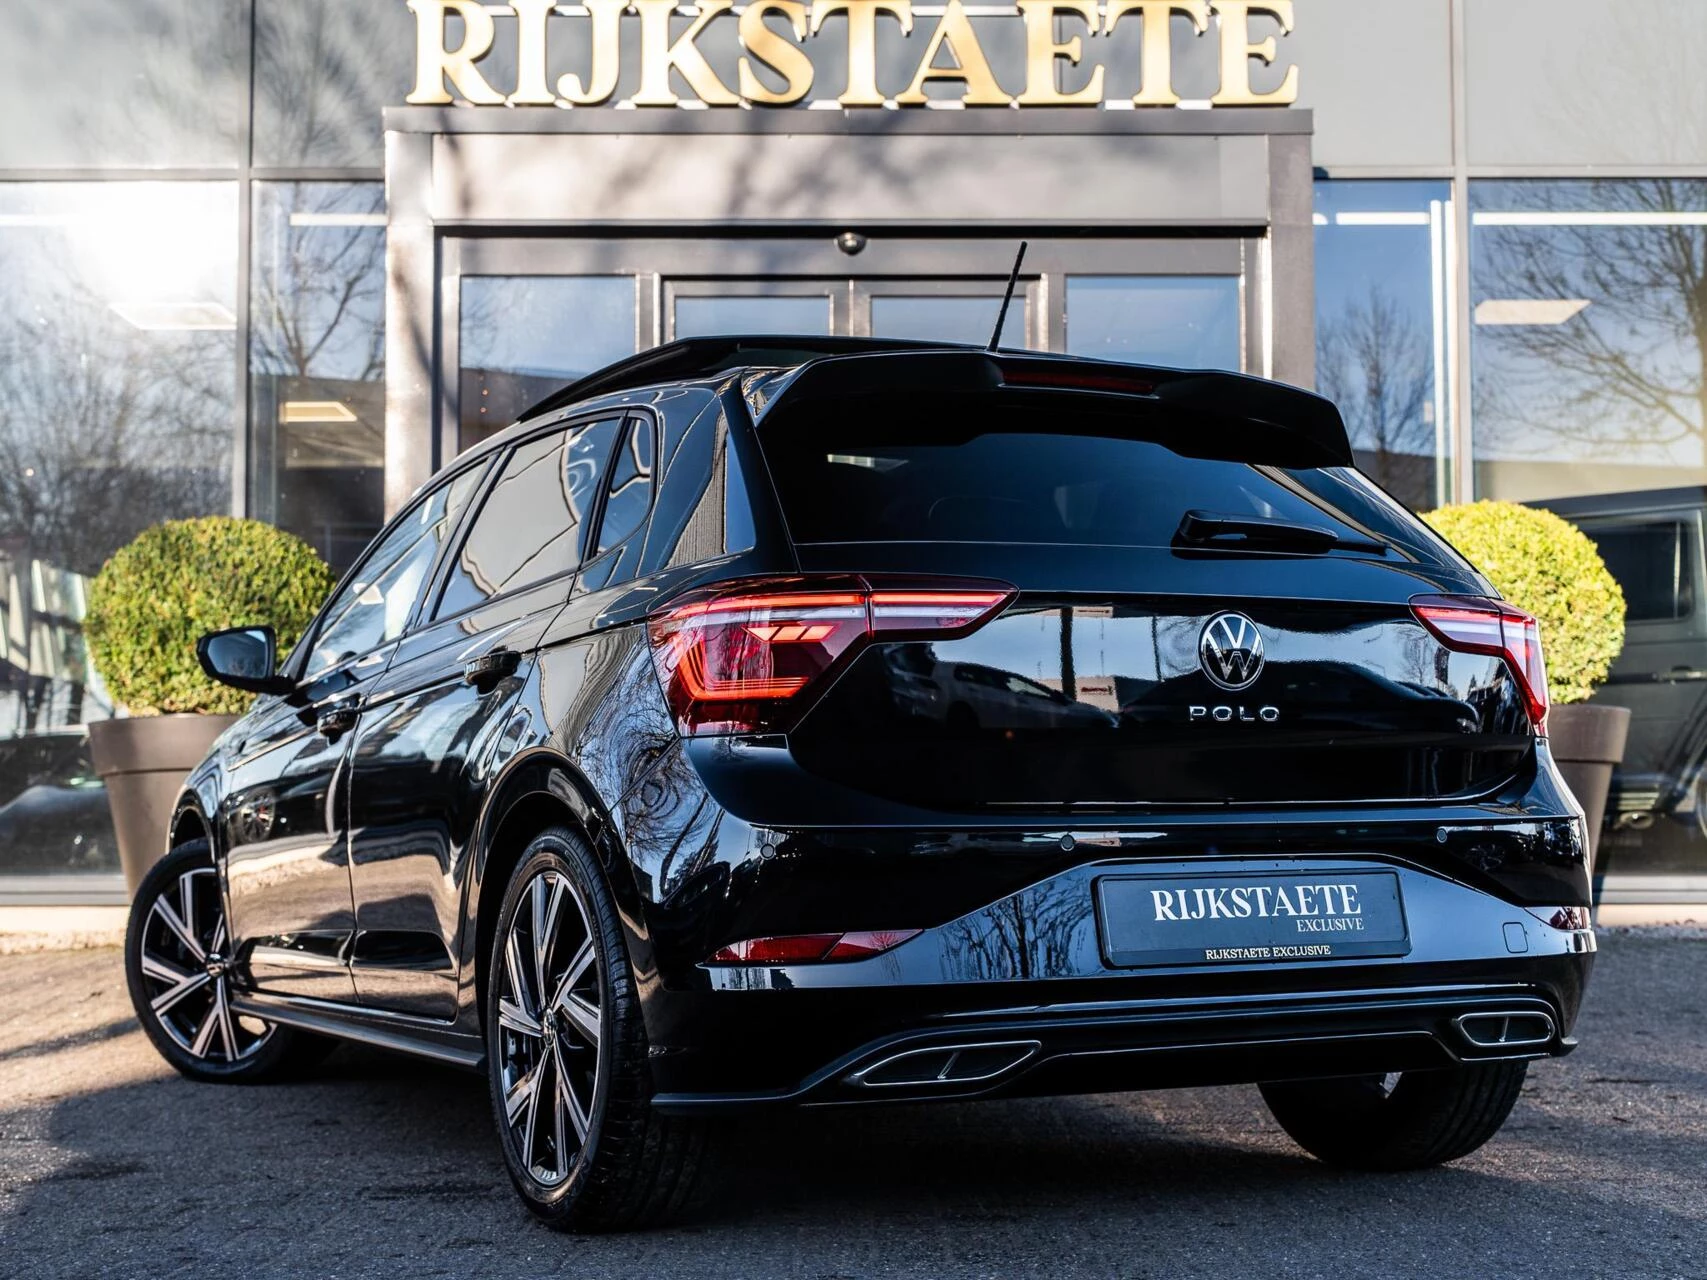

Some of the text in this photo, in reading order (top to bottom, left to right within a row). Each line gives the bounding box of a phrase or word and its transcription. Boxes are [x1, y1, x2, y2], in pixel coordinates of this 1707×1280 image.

[405, 0, 1299, 106] RIJKSTAETE
[1189, 705, 1280, 721] POLO
[1150, 884, 1362, 922] RIJKSTAETE
[1296, 917, 1365, 933] EXCLUSIVE
[1205, 945, 1332, 960] RIJKSTAETE EXCLUSIVE
